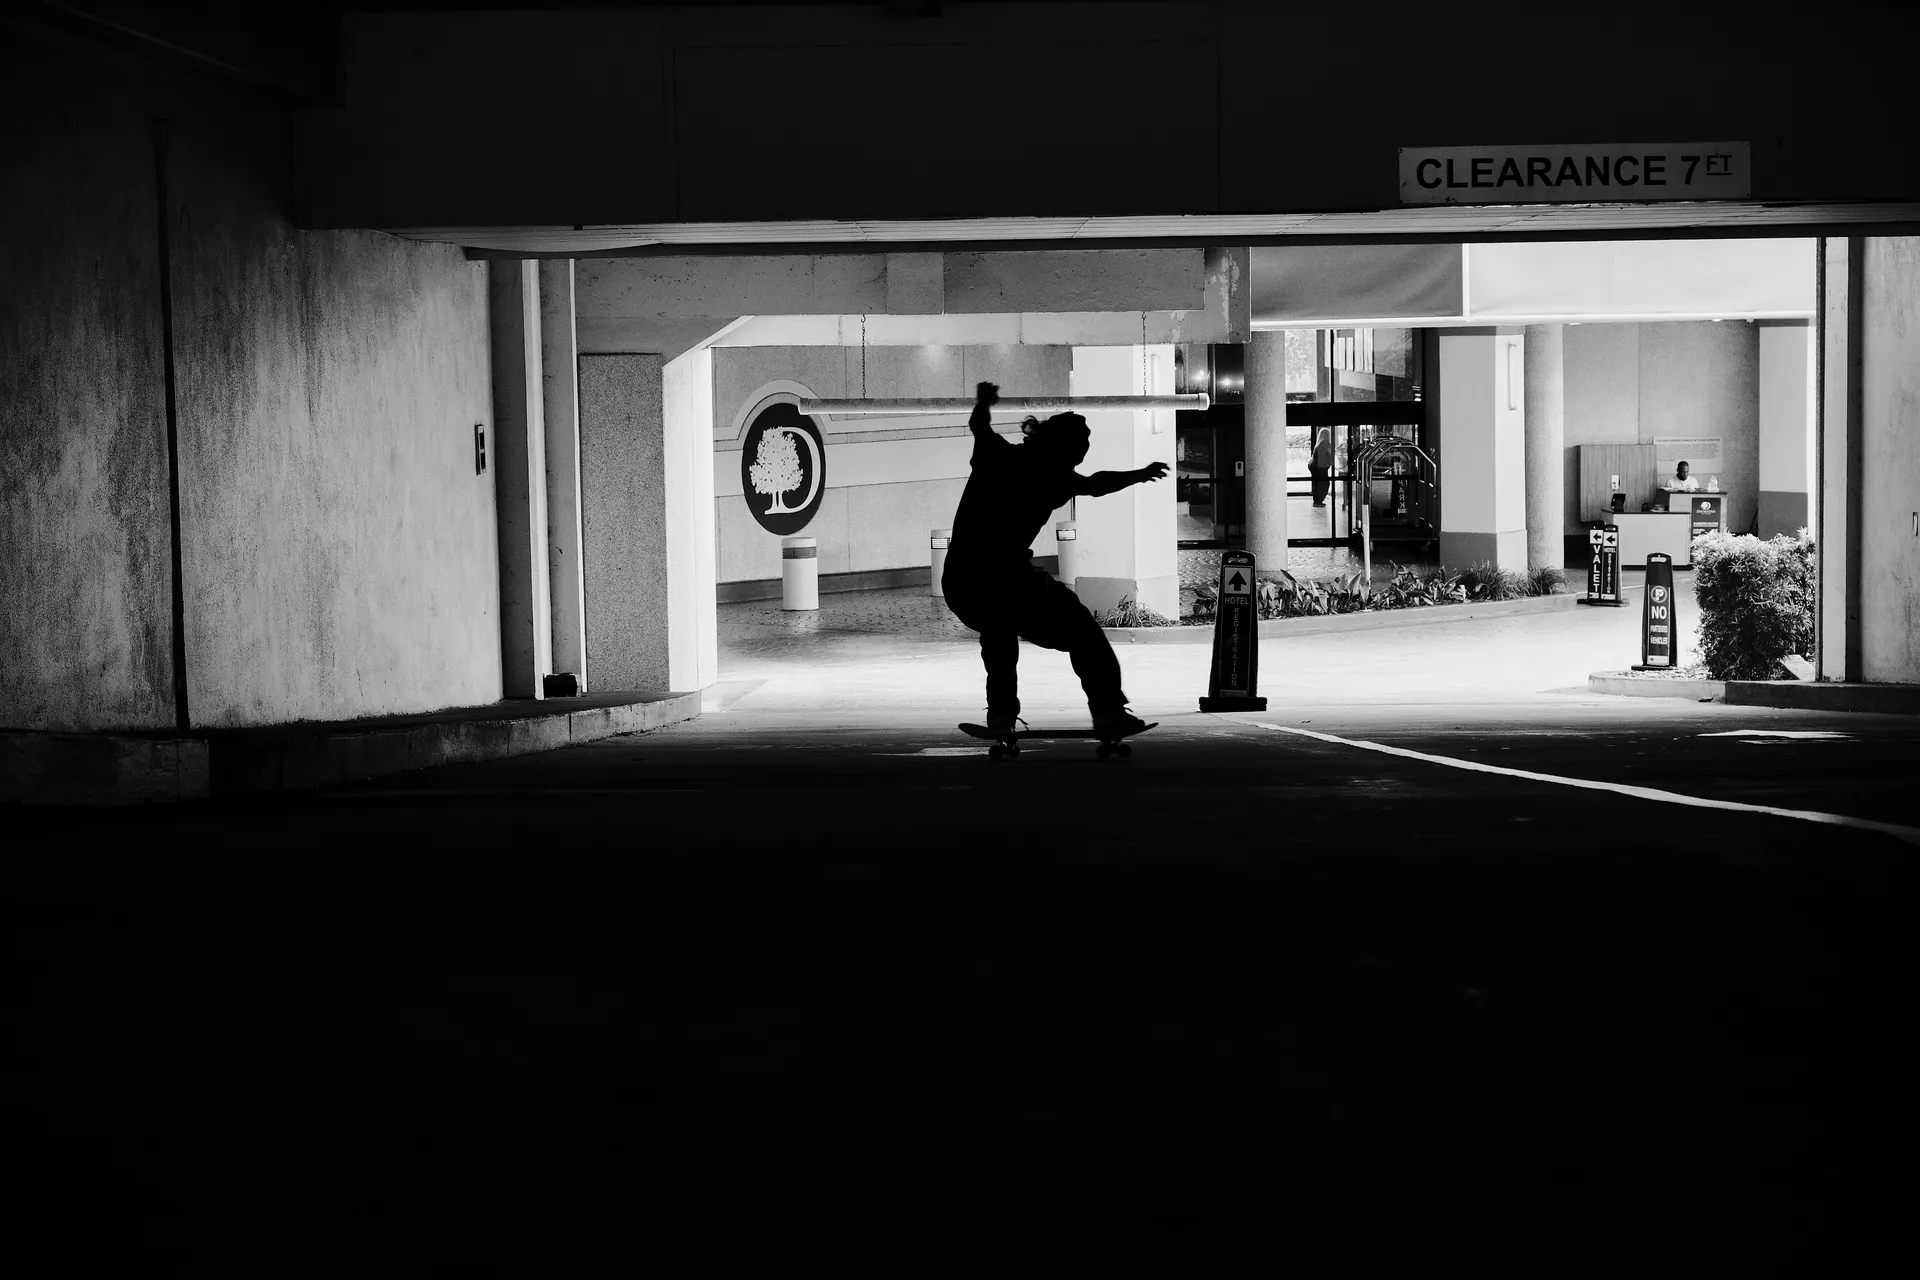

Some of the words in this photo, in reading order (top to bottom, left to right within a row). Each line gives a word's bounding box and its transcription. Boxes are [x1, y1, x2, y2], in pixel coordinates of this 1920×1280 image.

[1416, 155, 1667, 189] CLEARANCE
[1680, 155, 1701, 186] 7
[1705, 154, 1733, 173] FT
[1592, 544, 1601, 593] VALET
[1224, 596, 1250, 605] HOTEL
[1651, 605, 1667, 620] NO
[1231, 607, 1240, 687] REGISTRATION
